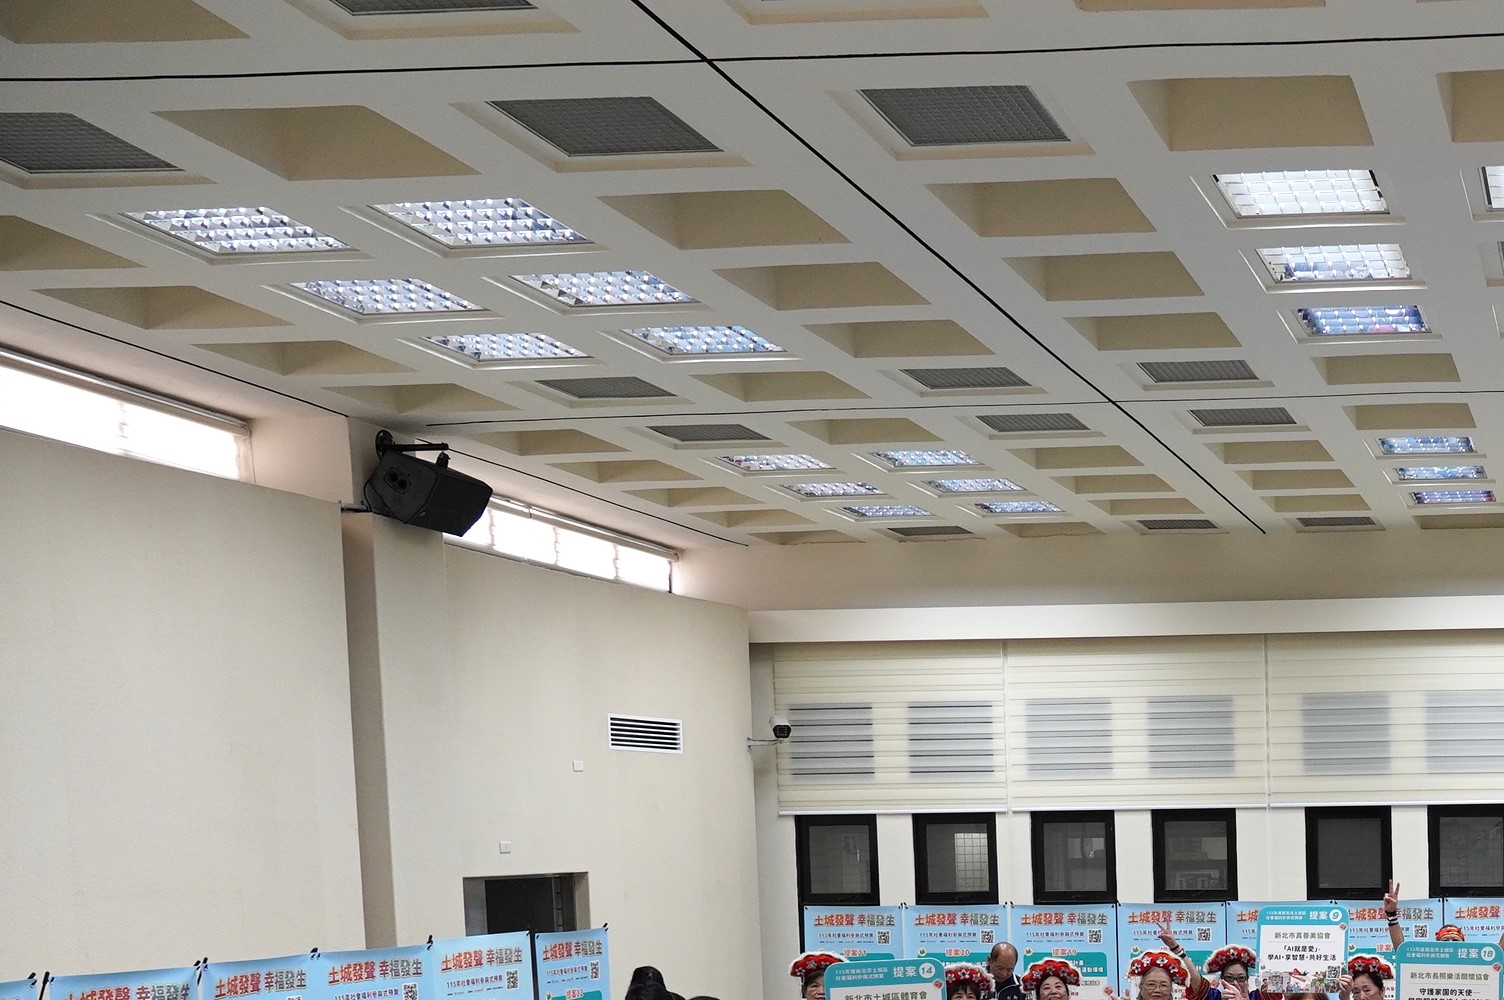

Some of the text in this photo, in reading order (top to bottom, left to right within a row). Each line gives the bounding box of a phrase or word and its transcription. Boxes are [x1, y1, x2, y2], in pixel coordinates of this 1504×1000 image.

[915, 913, 999, 926] 土城發聲 幸福發生
[441, 947, 522, 971] 土城發聲 幸福發生
[542, 940, 602, 962] 土城發聲 幸福發生
[328, 959, 423, 985] 土城發聲 幸福發生
[893, 966, 933, 978] 提案 14
[215, 969, 306, 999] 土城發聲 幸福發生
